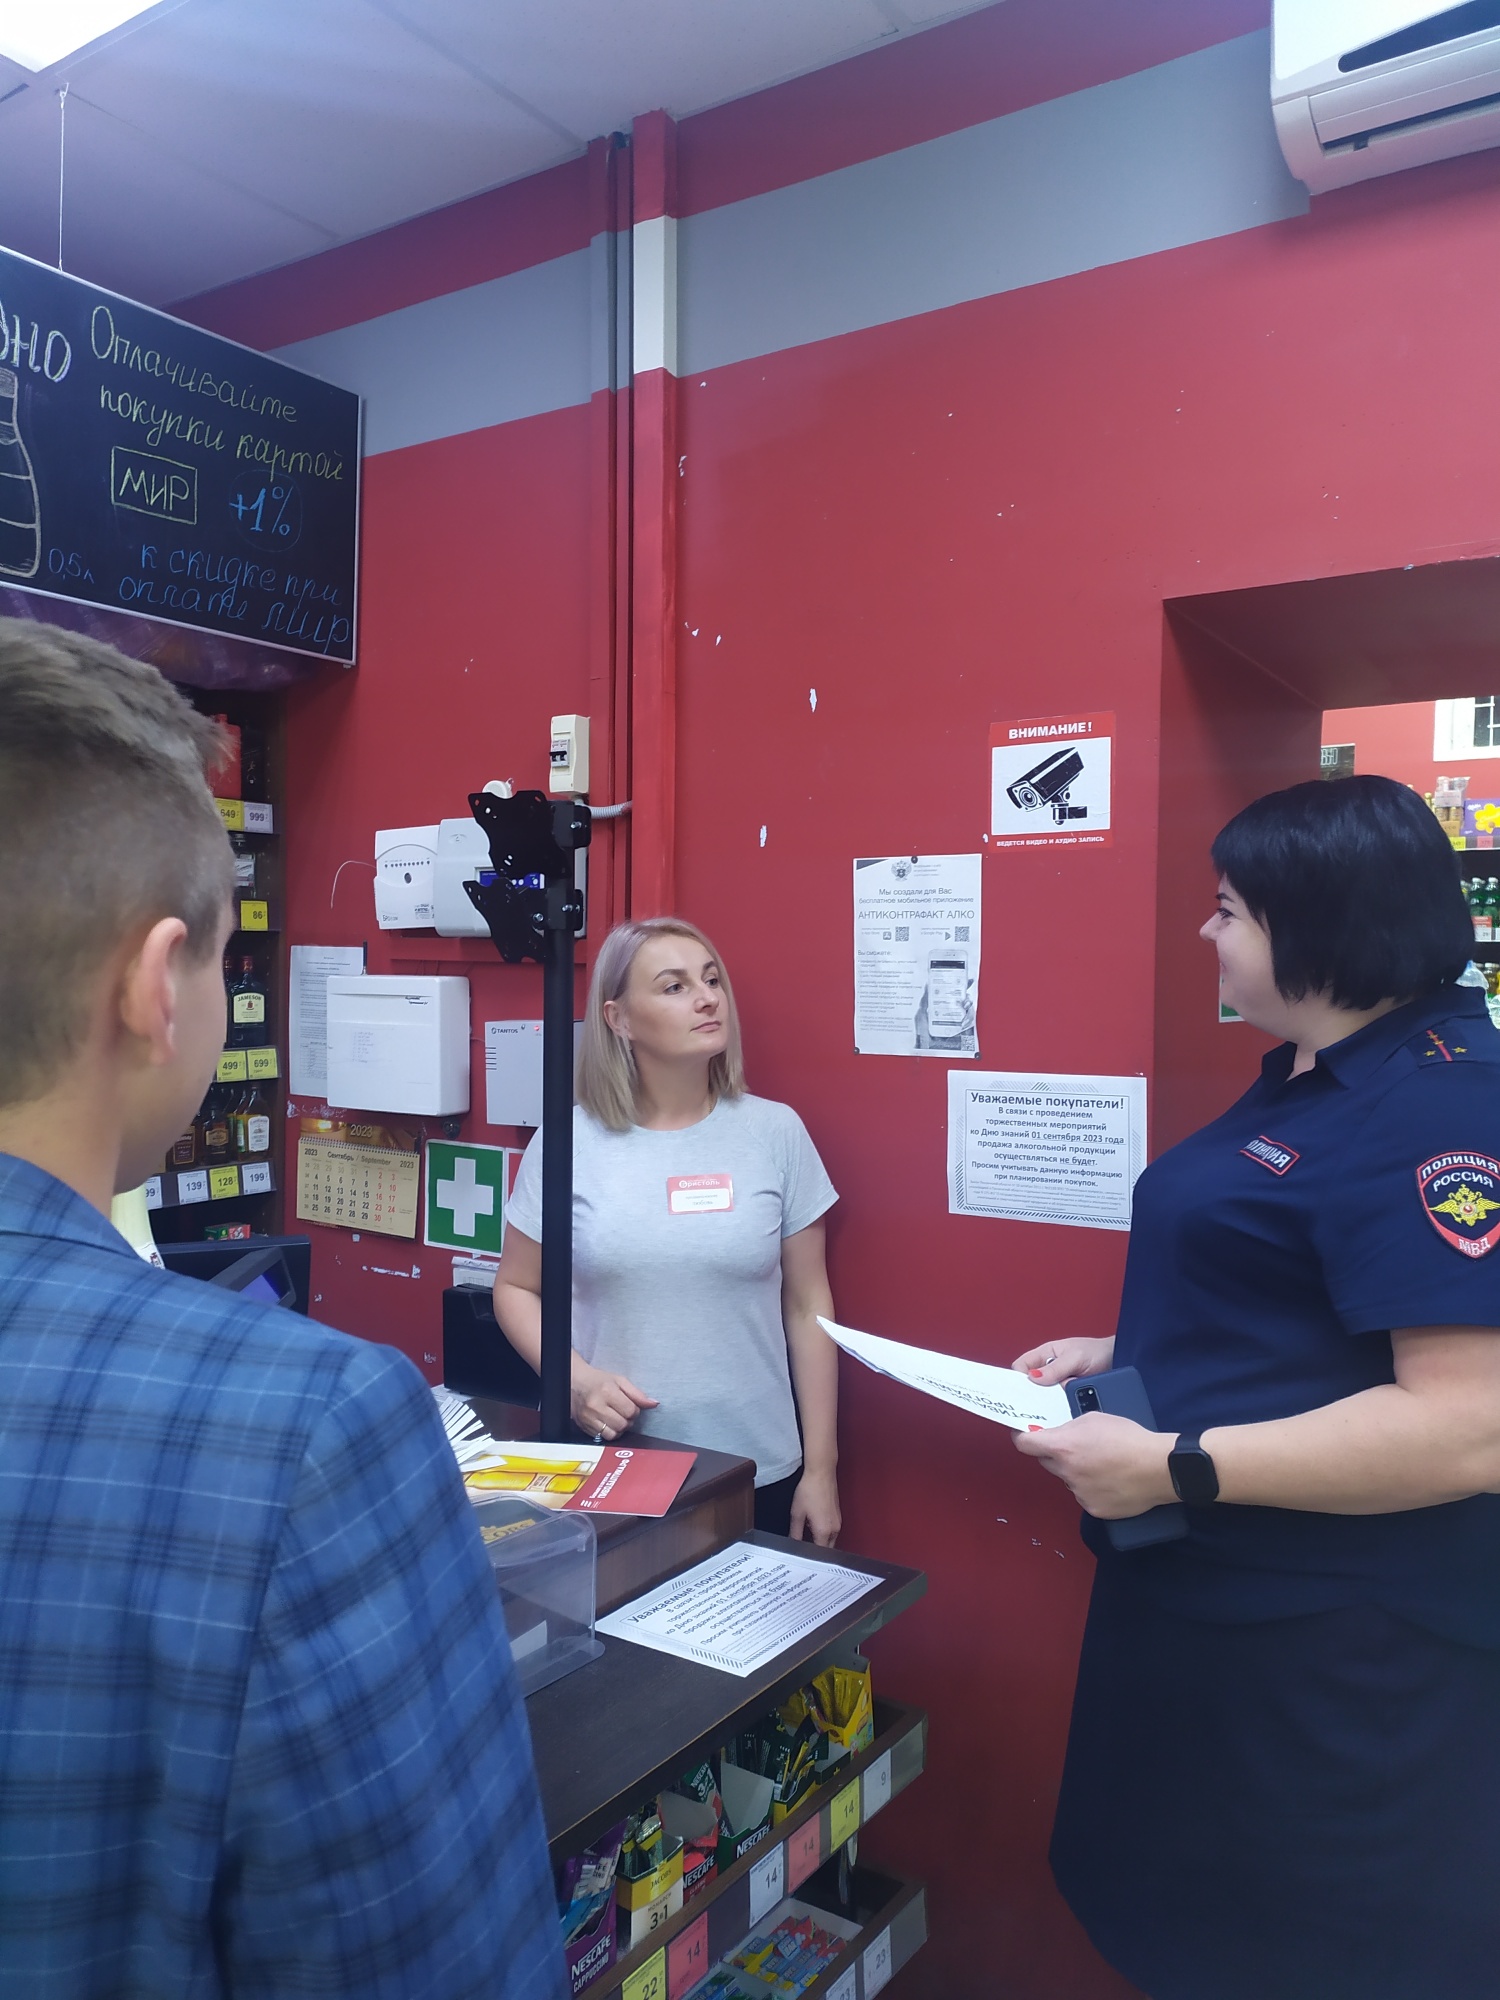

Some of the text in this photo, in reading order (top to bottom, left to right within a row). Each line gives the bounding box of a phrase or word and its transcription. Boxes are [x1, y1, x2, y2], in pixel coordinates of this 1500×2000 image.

[92, 306, 297, 422] Оплачивайте
[100, 385, 343, 482] покупки картой
[119, 468, 189, 511] МИР
[229, 485, 294, 536] +1%
[170, 549, 276, 604] скидке
[285, 574, 342, 610] при
[119, 576, 248, 620] оплате
[250, 813, 264, 821] 999
[878, 887, 952, 896] Мы создали для Вас
[897, 896, 932, 904] мобильное
[253, 911, 263, 919] 86
[858, 910, 975, 920] АНТИКОНТРАФАКТ АЛКО
[254, 1059, 269, 1067] 699
[971, 1092, 1123, 1109] Уважаемые покупатели!
[1035, 1110, 1092, 1118] проведением
[350, 1124, 373, 1138] 2023
[985, 1118, 1106, 1130] торжественных мероприятий
[1042, 1132, 1080, 1141] сентября
[1083, 1134, 1102, 1142] 2023
[304, 1148, 318, 1156] 2023
[977, 1140, 1115, 1155] продажа алкогольной продукции
[327, 1151, 354, 1162] Сентябрь
[361, 1156, 391, 1166] September
[993, 1152, 1057, 1162] осуществляться
[1071, 1156, 1097, 1165] будет.
[1039, 1167, 1068, 1175] данную
[1070, 1168, 1122, 1178] информацию
[1422, 1156, 1499, 1179] ПОЛИЦИЯ
[218, 1177, 233, 1186] 128
[250, 1173, 265, 1182] 199
[1009, 1174, 1062, 1183] планировании
[1433, 1172, 1493, 1192] РОССИЯ
[186, 1181, 202, 1191] 139
[1459, 1237, 1490, 1256] МВД
[881, 1771, 886, 1786] 9
[844, 1800, 854, 1818] 14
[804, 1837, 814, 1856] 14
[651, 1869, 671, 1889] JACOBS
[766, 1867, 777, 1889] 14
[648, 1892, 672, 1911] MONARCH
[687, 1940, 700, 1964] 14
[875, 1950, 886, 1969] 23
[574, 1952, 609, 1993] CAPPUCCINO
[642, 1977, 658, 2000] 22
